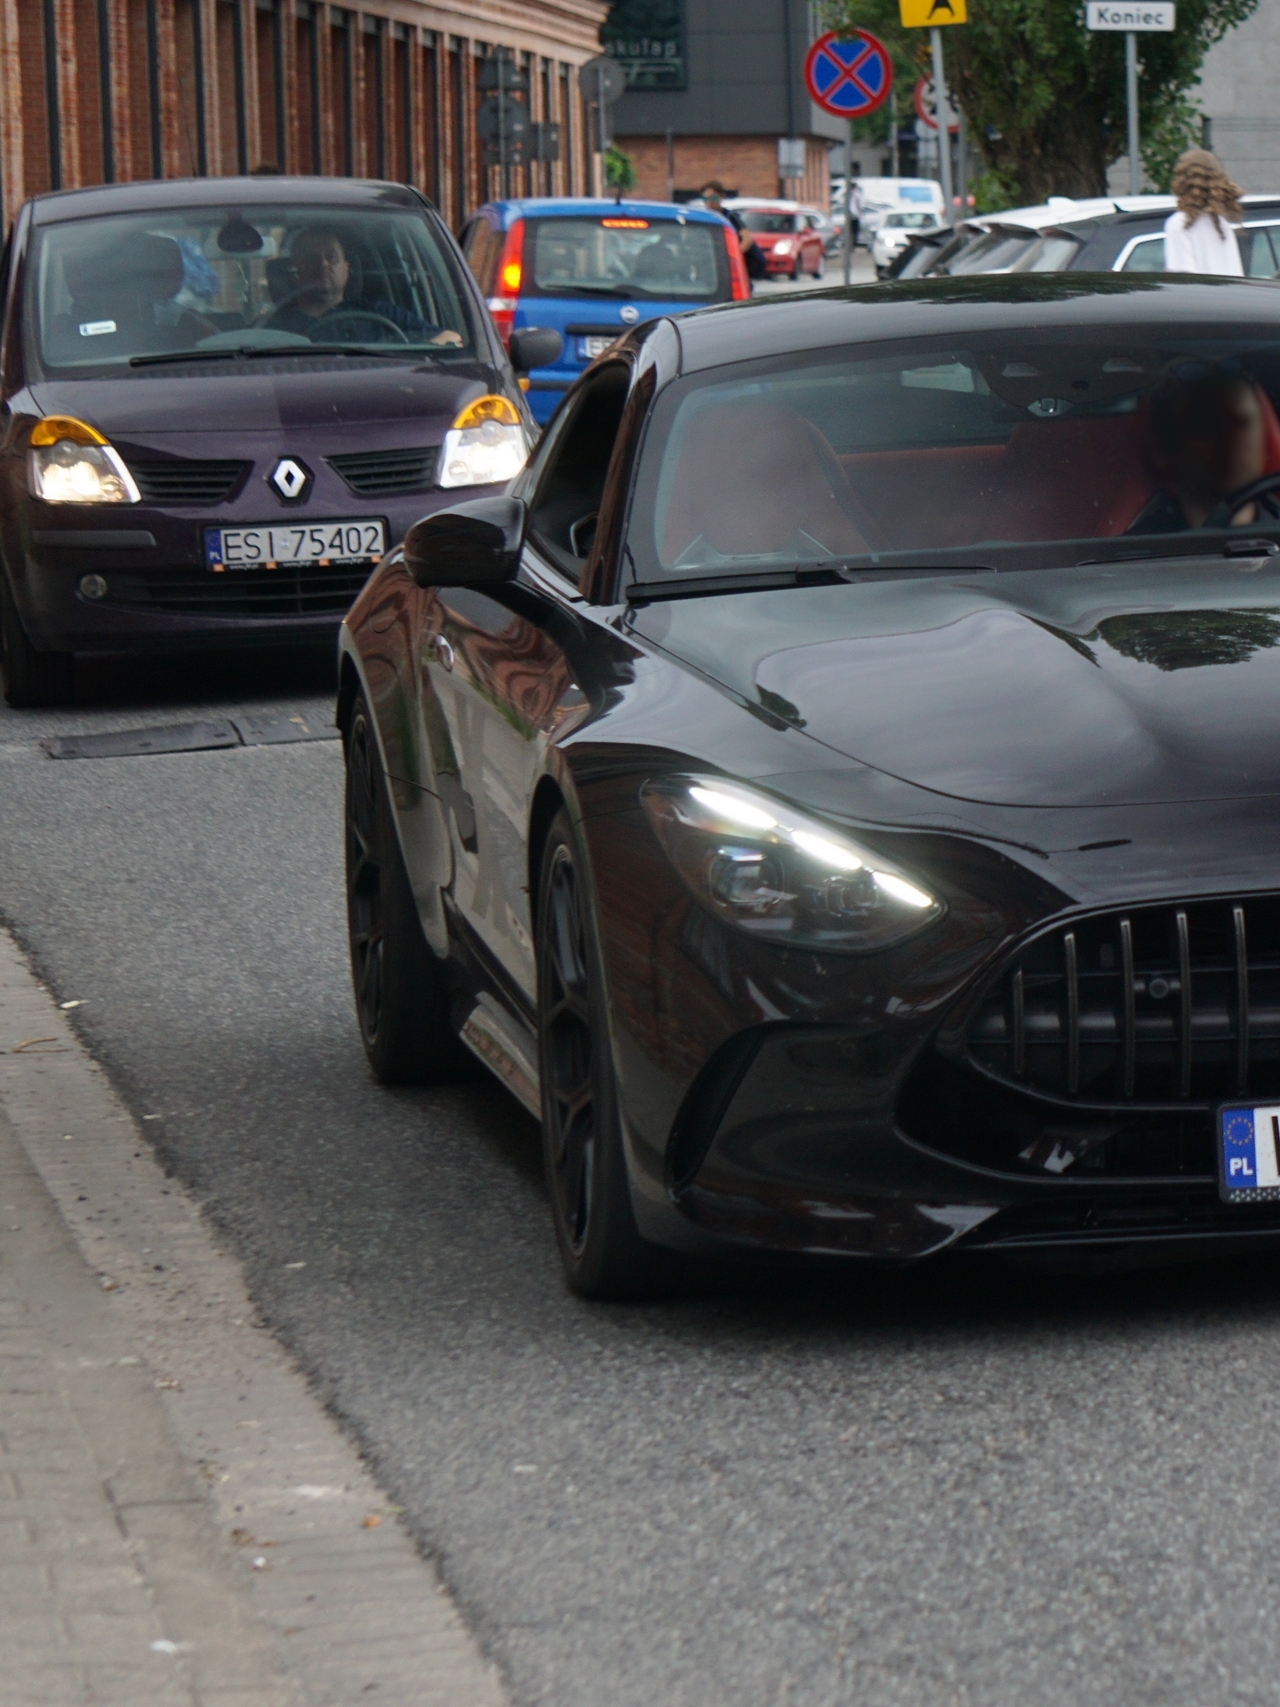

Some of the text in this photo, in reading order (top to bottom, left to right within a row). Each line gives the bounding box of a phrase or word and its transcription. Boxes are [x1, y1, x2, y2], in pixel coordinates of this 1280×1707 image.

[1097, 7, 1164, 25] Koniec
[223, 526, 380, 561] ESI 75402
[1230, 1157, 1253, 1176] PL
